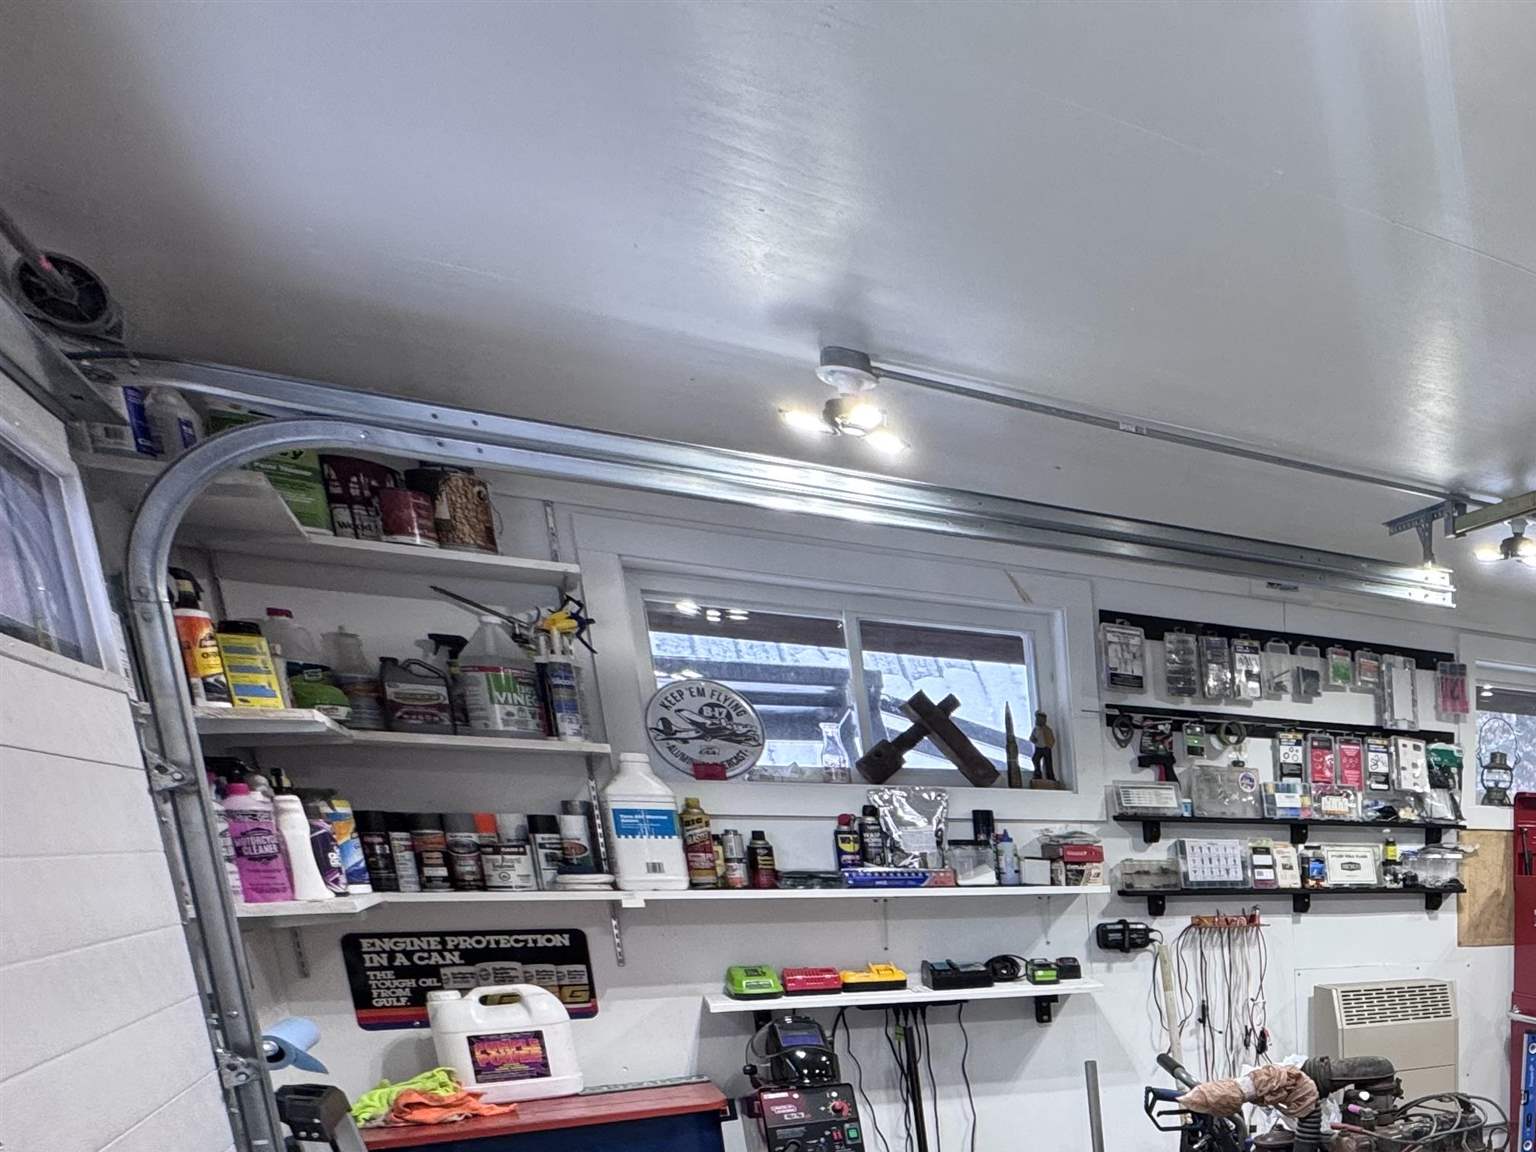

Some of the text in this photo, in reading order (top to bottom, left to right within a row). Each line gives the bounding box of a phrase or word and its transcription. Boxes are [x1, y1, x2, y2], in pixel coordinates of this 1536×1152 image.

[658, 687, 685, 711] KEEP
[710, 688, 748, 718] FLYING
[702, 706, 728, 719] B-17
[360, 934, 571, 951] ENGINE PROTECTION
[363, 951, 464, 967] IN A CAN.
[367, 971, 395, 980] THE
[370, 979, 416, 988] TOUGH
[418, 977, 441, 987] OIL
[372, 988, 412, 997] FROM
[372, 996, 411, 1006] GULF.
